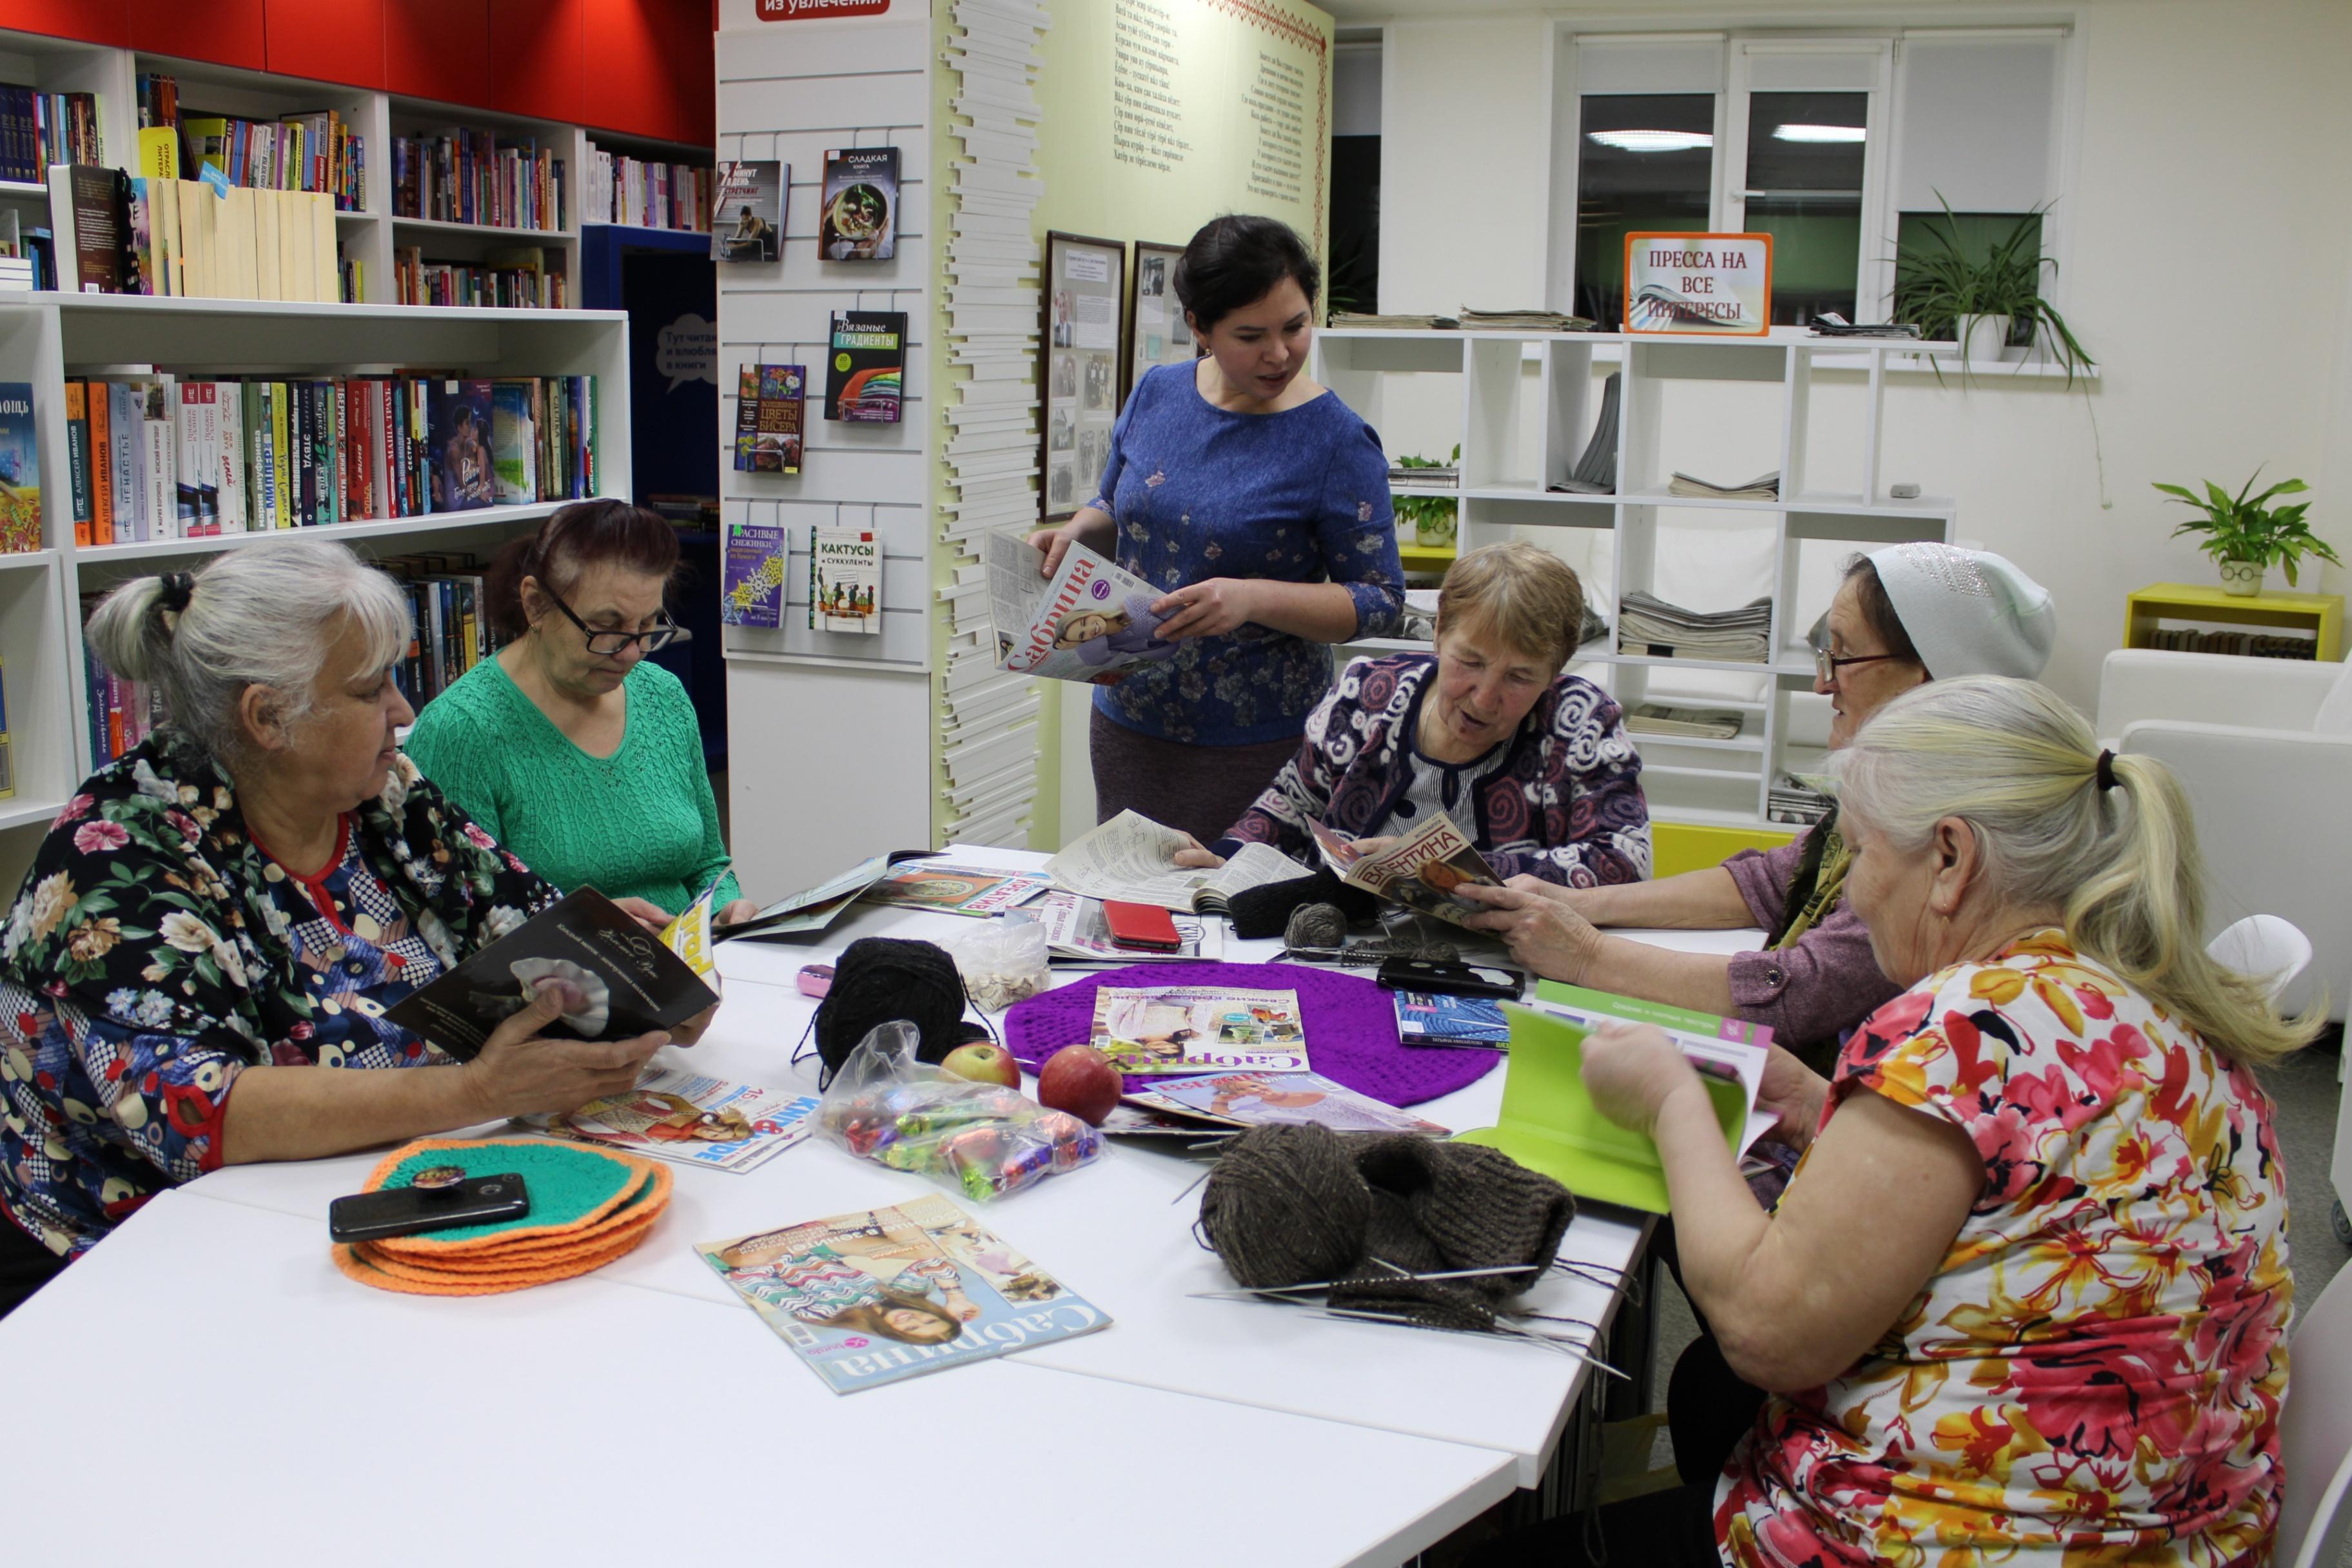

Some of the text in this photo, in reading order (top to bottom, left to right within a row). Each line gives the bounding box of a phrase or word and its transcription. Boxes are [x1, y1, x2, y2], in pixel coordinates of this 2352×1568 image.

[1650, 250, 1747, 269] ПРЕССА НА
[1681, 276, 1714, 294] ВСЕ
[1648, 301, 1742, 320] ИНТЕРЕСЫ
[838, 319, 886, 333] Вязаные
[841, 334, 894, 346] ГРАДИЕНТЫ
[674, 360, 707, 370] книги
[337, 391, 346, 438] БЕРРОУЗ
[761, 409, 798, 420] ЦВЕТЫ
[759, 420, 797, 433] БИСЕРА
[303, 434, 311, 469] ЭТВУД
[386, 425, 395, 459] МАША
[70, 425, 82, 494] АЛЕКСЕЙ ИВАНОВ
[255, 429, 264, 491] ануфриева
[397, 425, 406, 484] МИНИ-МОДЕЛЬ
[121, 433, 131, 504] НЕНАСТЬЕ
[98, 441, 110, 524] АЛЕКСЕЙ ИВАНОВ
[731, 539, 773, 548] СНЕЖИНКИ,
[821, 544, 874, 556] КАКТУСЫ
[1008, 558, 1096, 671] Сабрина
[966, 878, 1035, 911] КРЕАТИВ
[741, 1088, 764, 1101] 15
[807, 1340, 846, 1355] burda
[832, 1304, 1097, 1377] Сабрина
